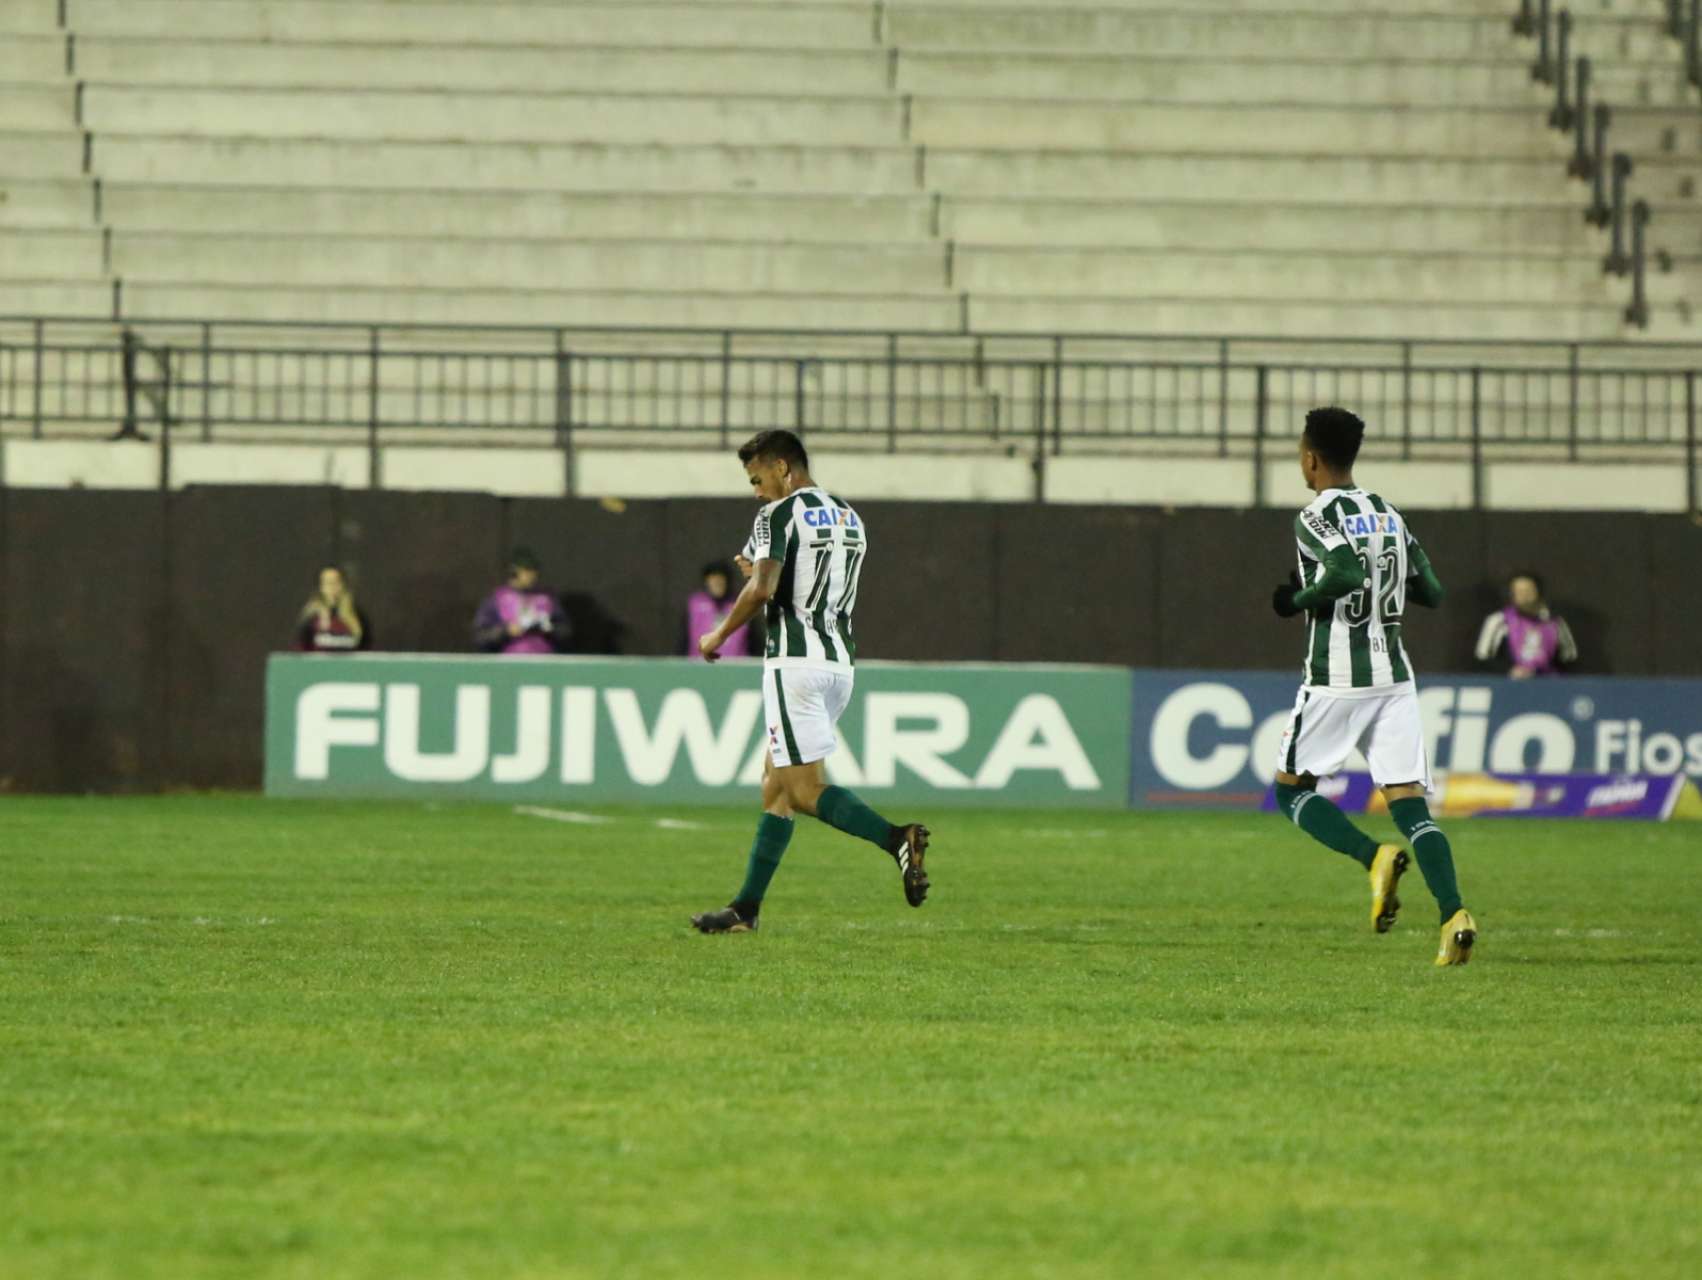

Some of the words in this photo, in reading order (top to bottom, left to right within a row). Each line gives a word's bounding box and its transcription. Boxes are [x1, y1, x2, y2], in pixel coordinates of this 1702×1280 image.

[803, 509, 858, 528] CAIXA
[1345, 514, 1398, 535] CAIXA
[805, 540, 866, 611] 77
[1342, 549, 1401, 627] 32
